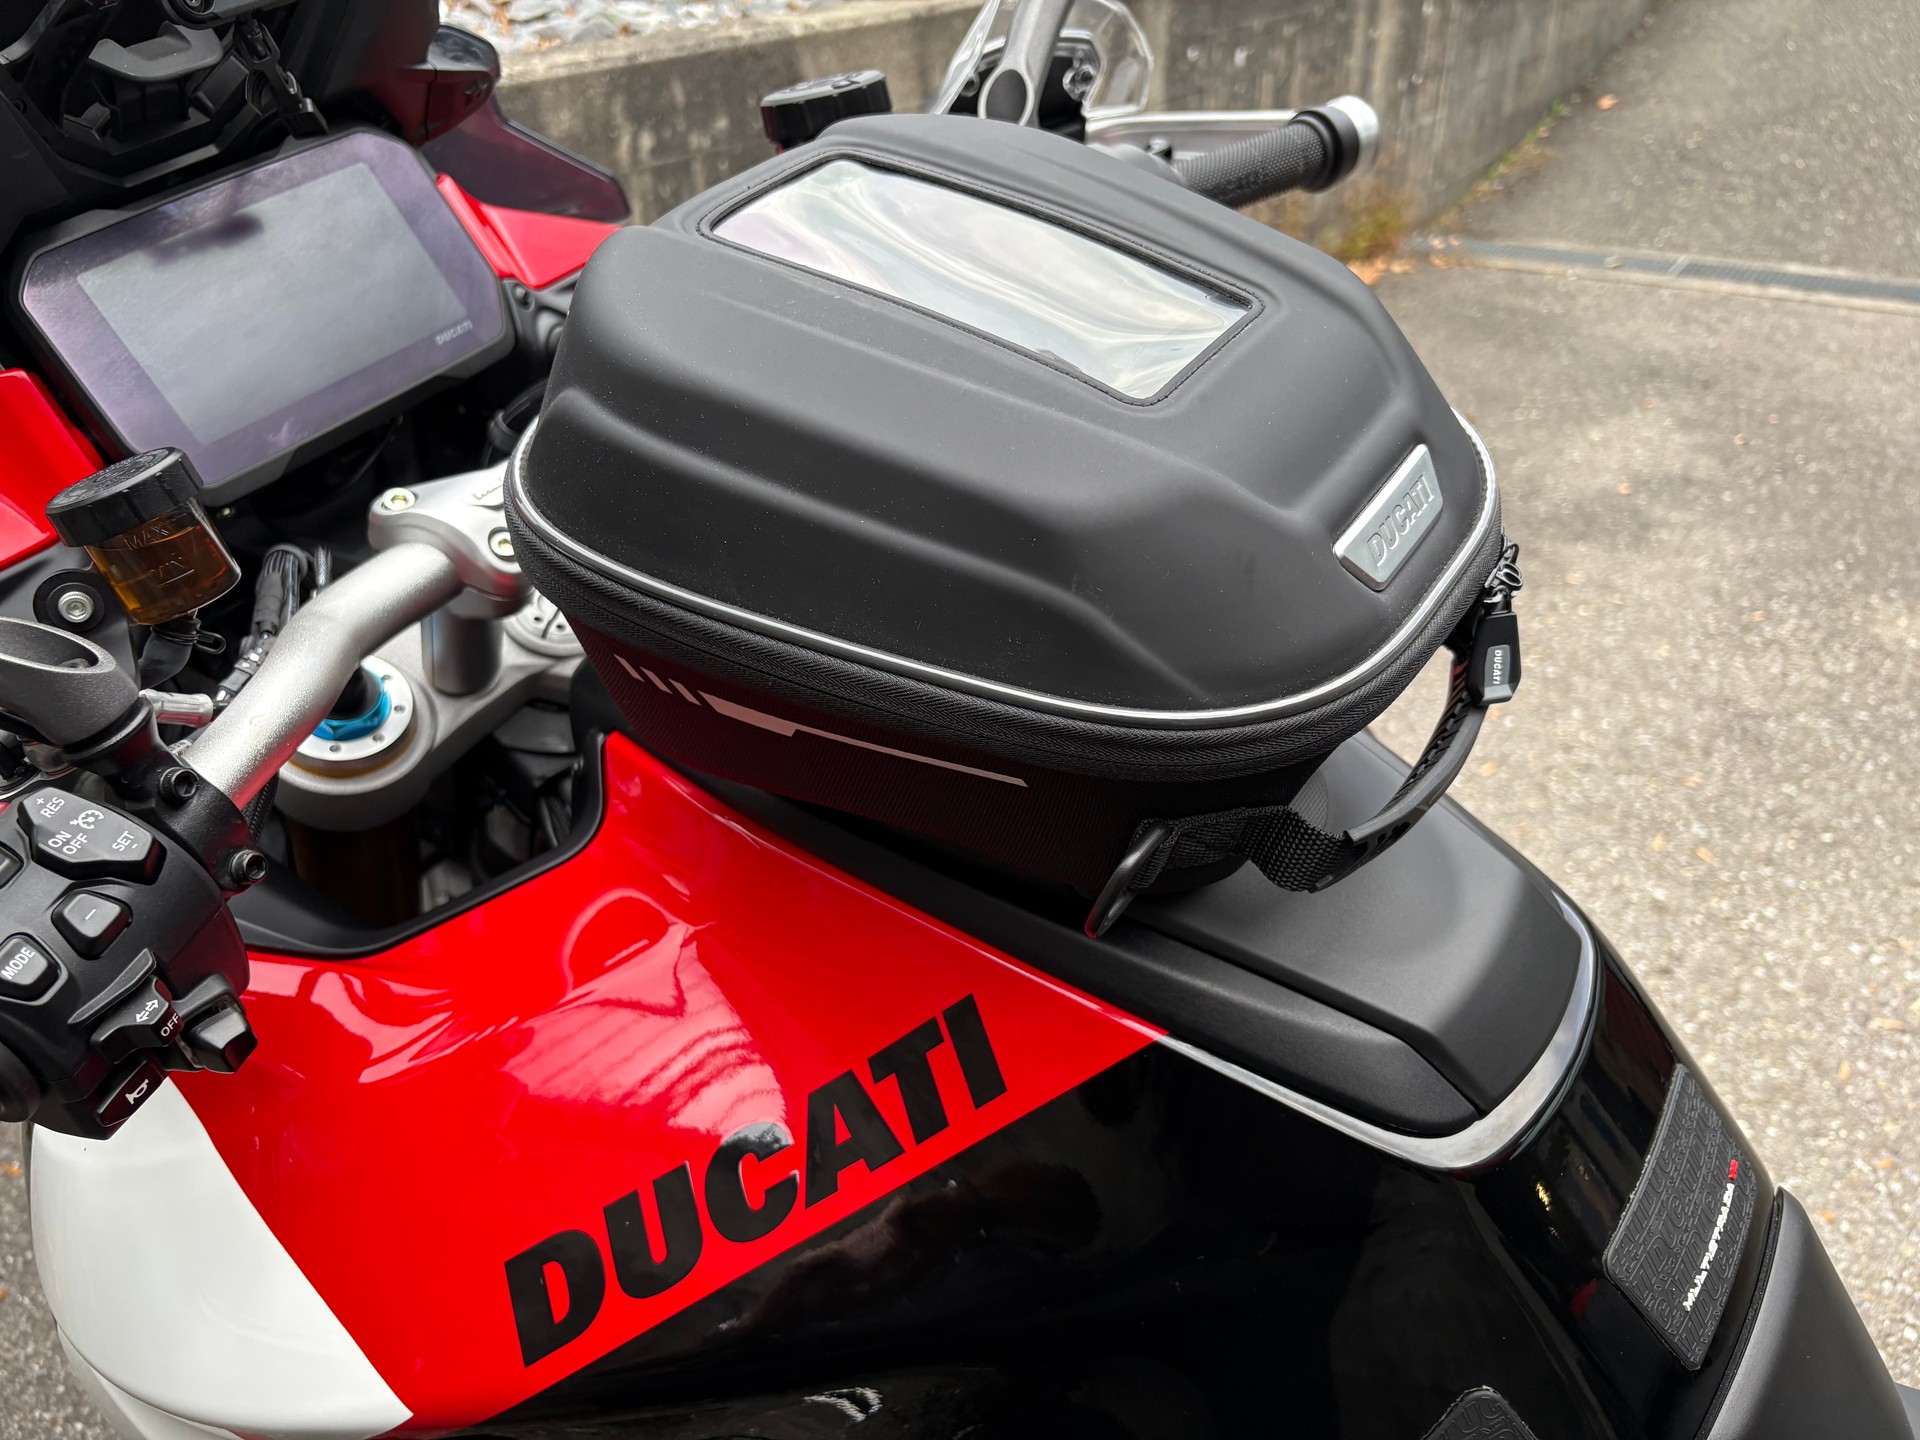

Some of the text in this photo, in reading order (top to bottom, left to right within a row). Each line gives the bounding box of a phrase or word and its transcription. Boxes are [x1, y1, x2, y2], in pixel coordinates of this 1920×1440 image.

[1366, 474, 1436, 568] DUCATI
[1492, 649, 1504, 685] DUCATI
[40, 796, 66, 818] RES
[47, 830, 73, 848] ON
[62, 832, 88, 855] OFF
[111, 830, 136, 852] SET
[0, 946, 36, 980] MODE
[160, 1012, 179, 1037] OFF
[503, 992, 1009, 1369] DUCATI
